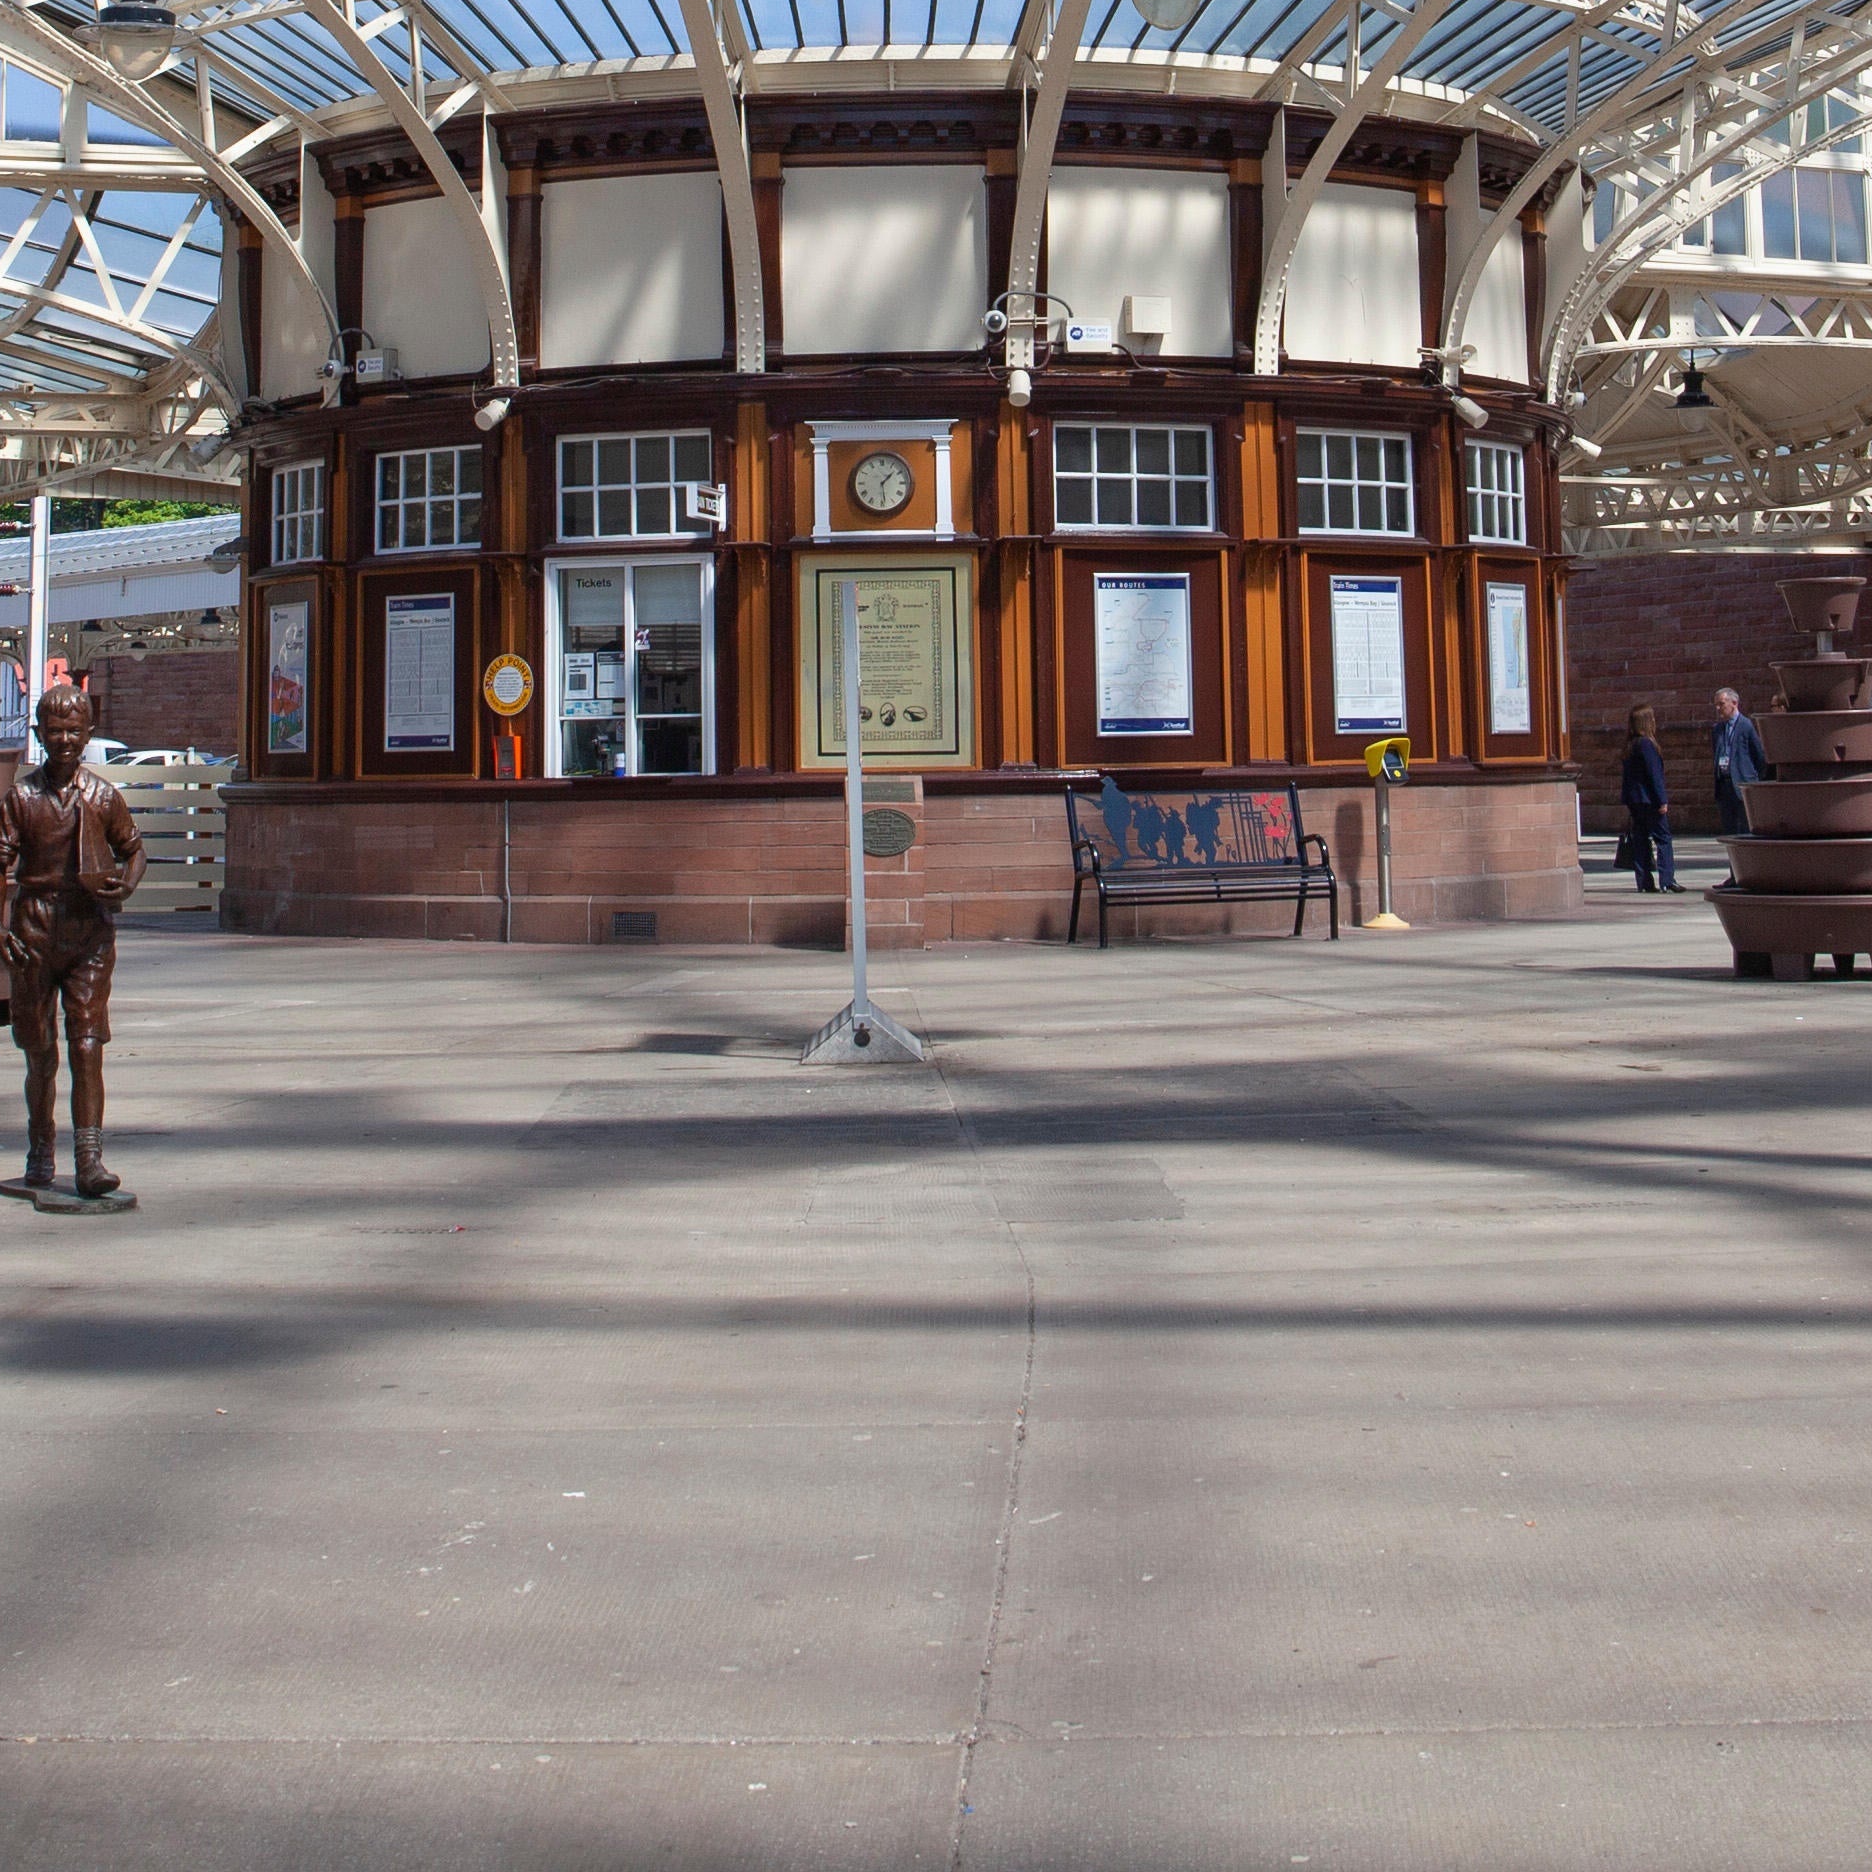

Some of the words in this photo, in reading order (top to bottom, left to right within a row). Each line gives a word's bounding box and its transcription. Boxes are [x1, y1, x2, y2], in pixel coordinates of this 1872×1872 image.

[576, 578, 612, 589] Tickets
[486, 658, 504, 682] HELP
[508, 656, 532, 682] POINT
